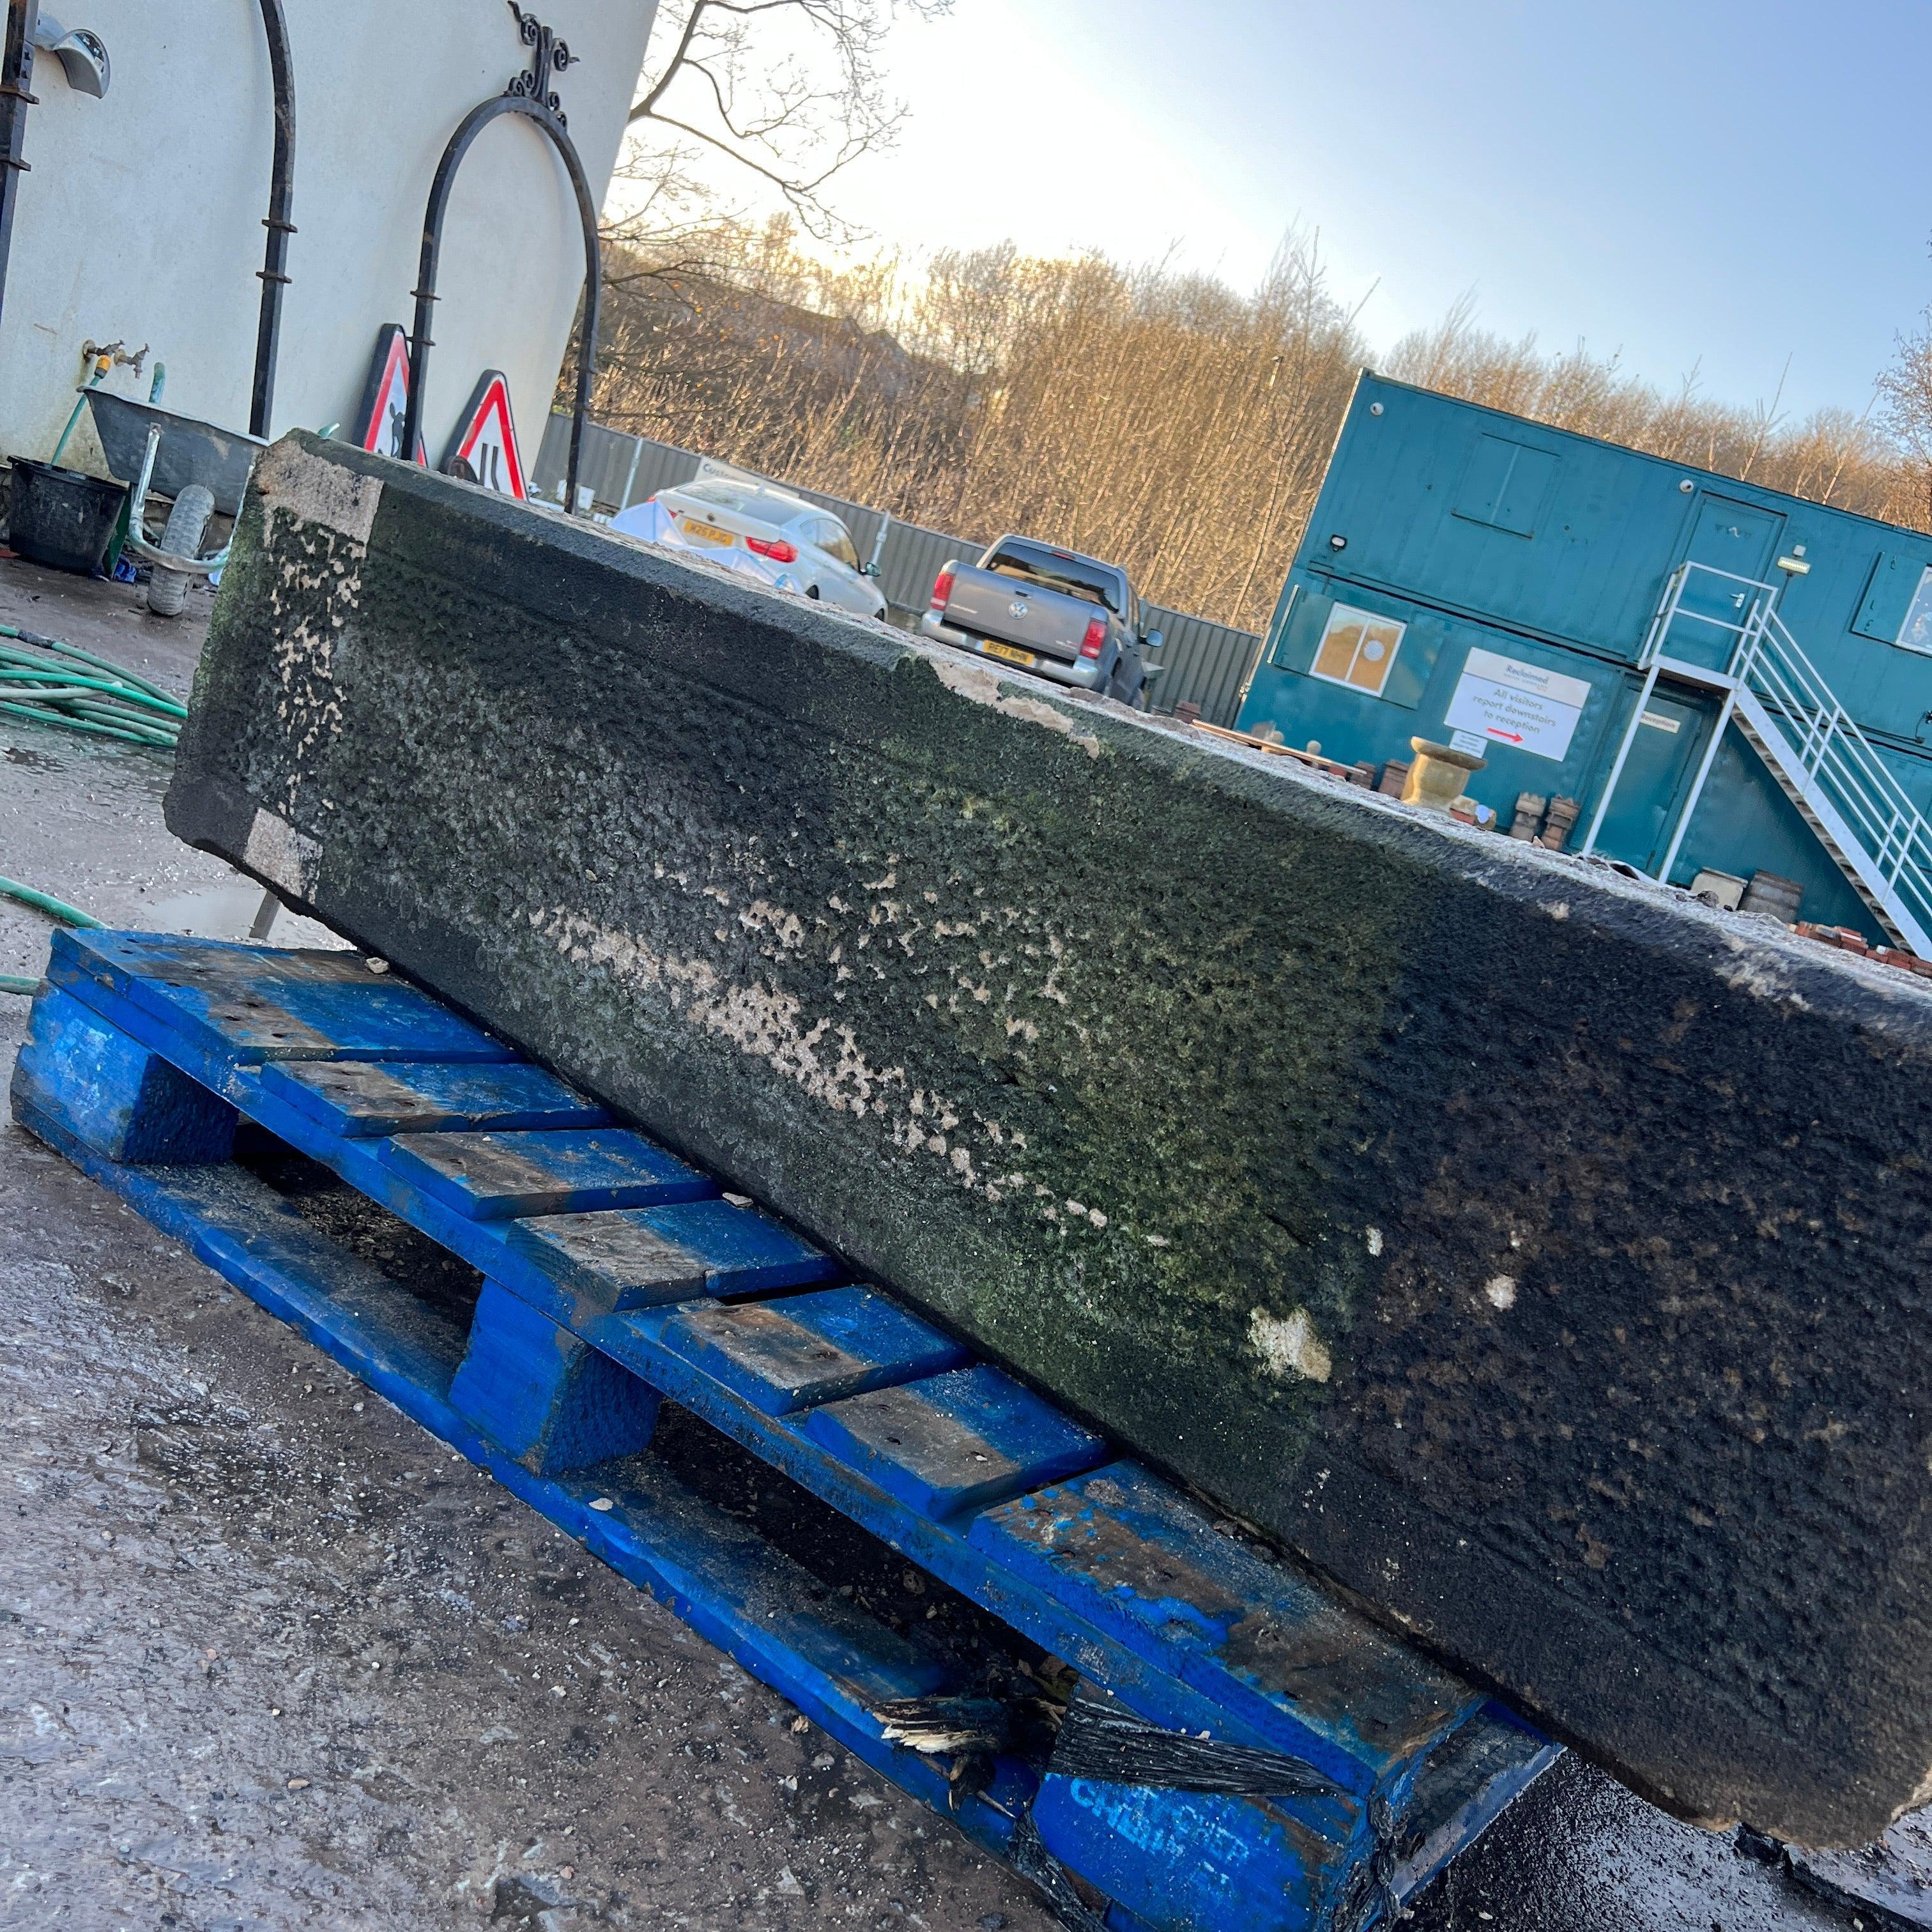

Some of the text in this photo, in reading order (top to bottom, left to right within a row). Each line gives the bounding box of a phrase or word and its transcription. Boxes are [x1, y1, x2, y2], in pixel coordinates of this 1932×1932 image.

[1506, 665, 1549, 684] Reclaimed
[1494, 689, 1543, 710] All visitors
[1473, 696, 1556, 726] report downstairs
[1484, 710, 1540, 733] to reception
